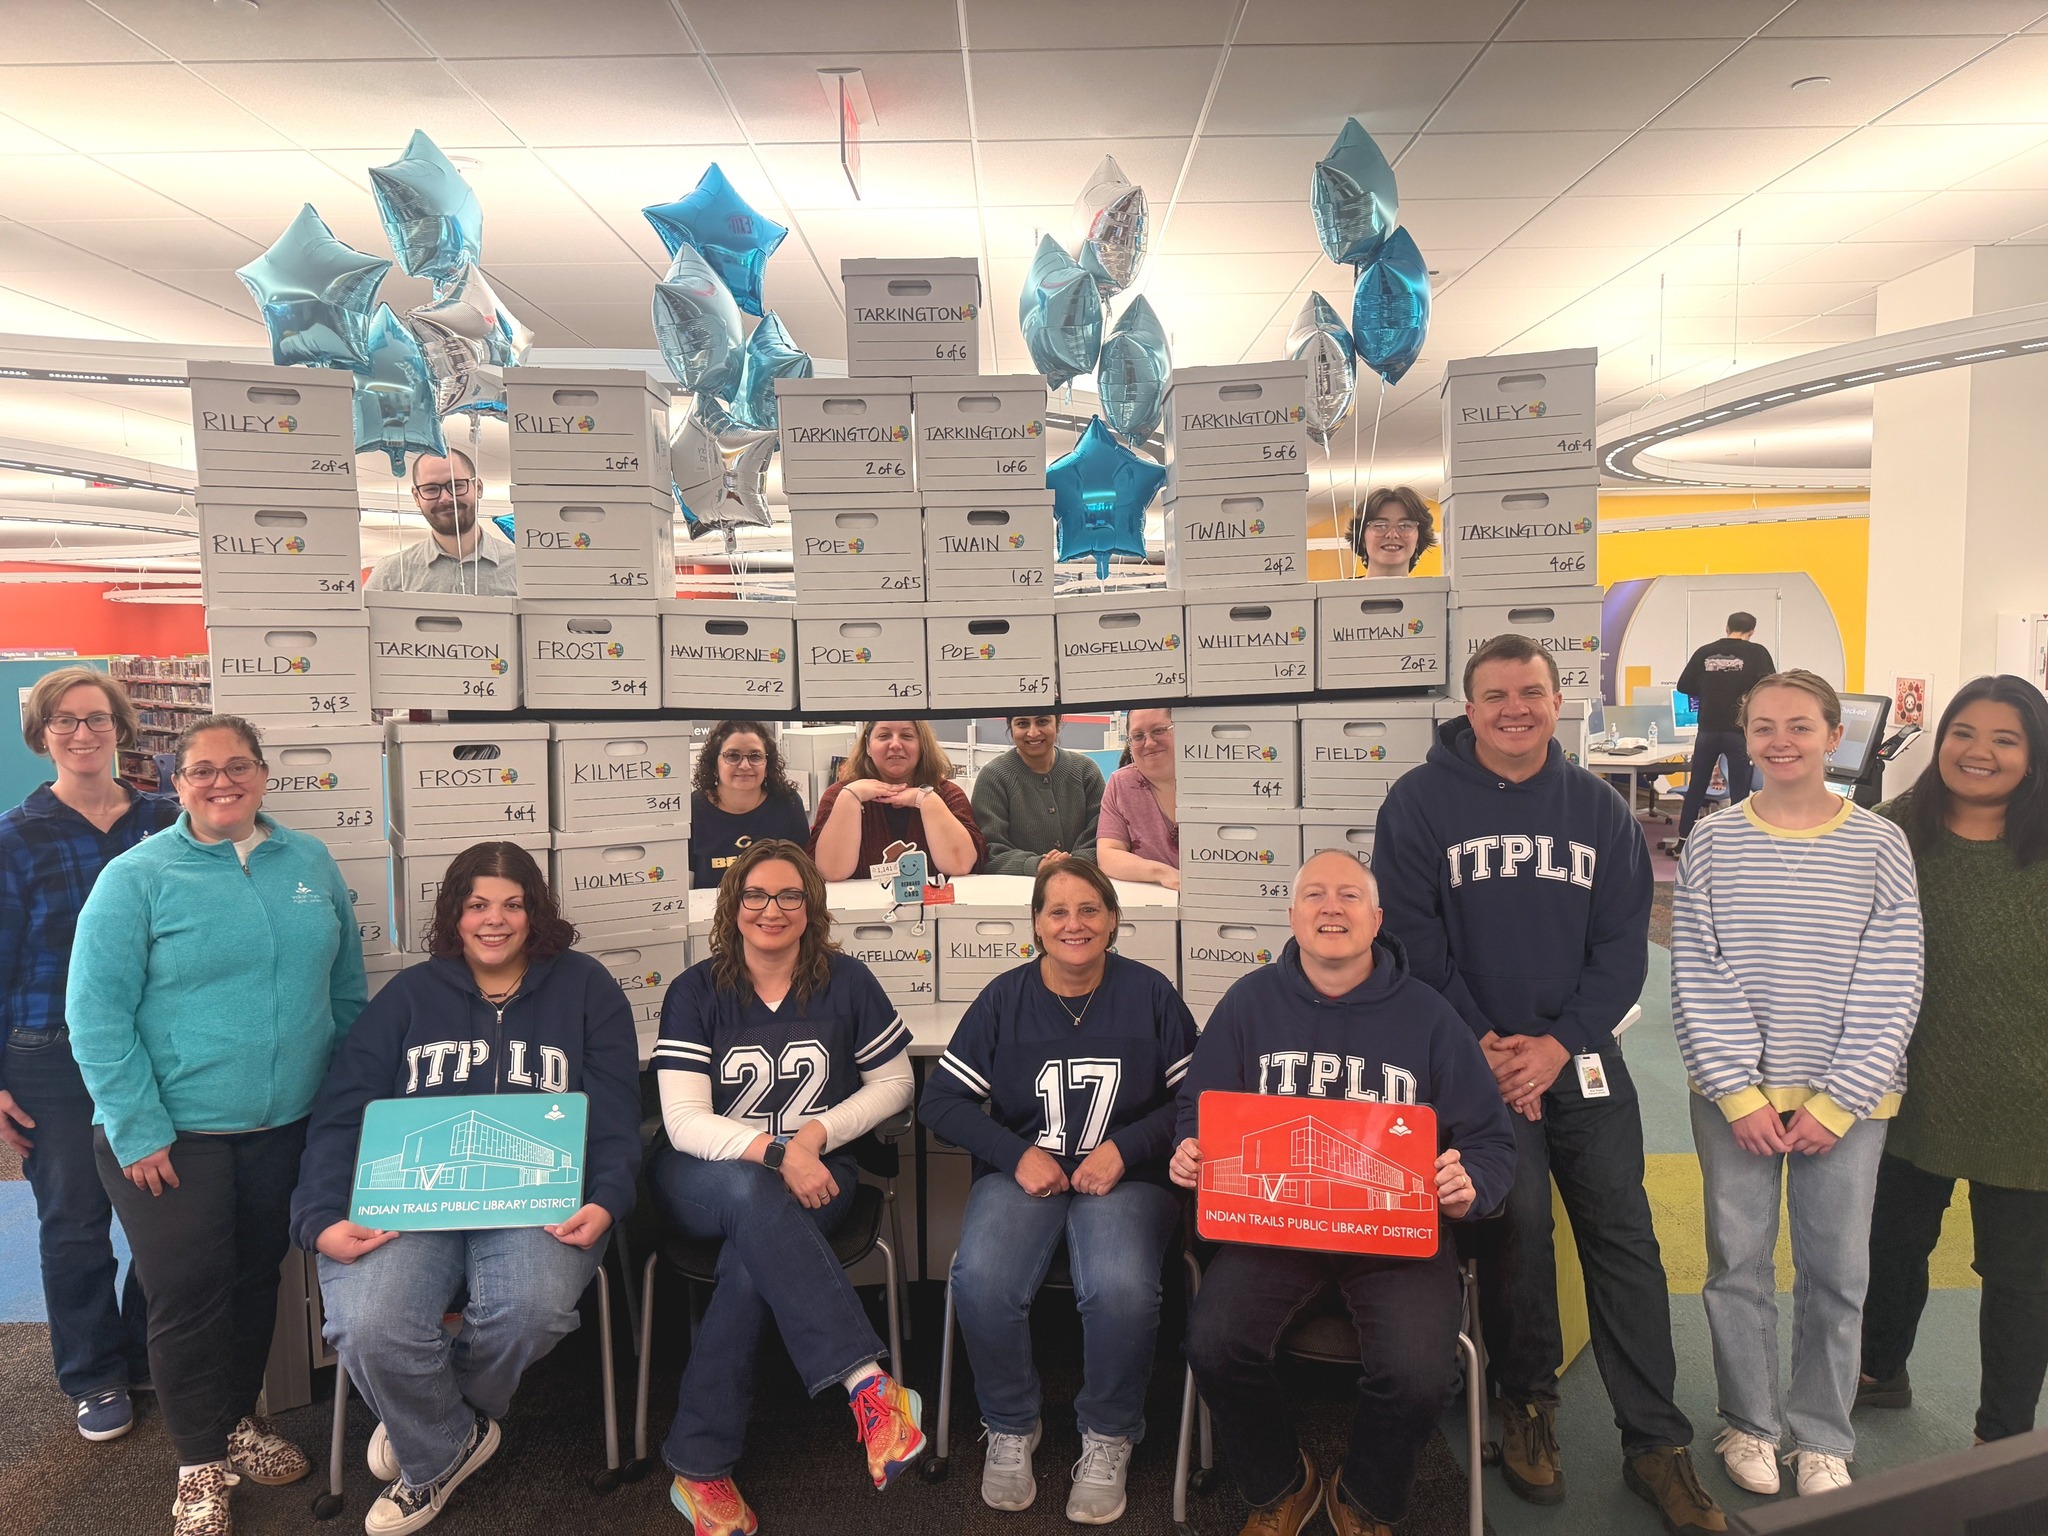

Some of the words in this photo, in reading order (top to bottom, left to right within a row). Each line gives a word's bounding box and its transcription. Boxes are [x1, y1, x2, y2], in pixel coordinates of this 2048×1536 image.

[854, 307, 963, 322] TARKINGTON
[203, 411, 276, 432] RILEY
[515, 411, 575, 433] RILEY
[1182, 408, 1290, 431] TARKINGTON
[1462, 404, 1528, 423] RILEY
[788, 426, 895, 443] TARKINGTON
[925, 424, 1026, 441] TARKINGTON
[526, 529, 571, 549] POE
[1186, 519, 1247, 541] TWAIN
[1459, 520, 1573, 541] TARKINGTON
[213, 534, 283, 555] RILEY
[805, 537, 848, 555] POE
[939, 535, 1000, 553] TWAIN
[1198, 630, 1290, 649] WHITMAN
[1333, 623, 1405, 641] WHITMAN
[375, 642, 500, 659] TARKINGTON
[538, 640, 609, 660] FROST
[671, 644, 770, 662] HAWTHORNE
[811, 646, 856, 664] POE
[941, 643, 980, 660] POE
[1064, 636, 1165, 656] LONGFELLOW
[222, 657, 292, 674] FIELD
[1184, 744, 1262, 761] KILMER
[1315, 746, 1368, 761] FIELD
[420, 767, 502, 788] FROST
[573, 761, 655, 785] KILMER
[267, 775, 320, 793] OPER
[1190, 847, 1258, 863] LONDON
[1446, 834, 1597, 890] ITPLD
[574, 870, 647, 892] HOLMES
[848, 949, 920, 963] GFELLOW
[950, 942, 1019, 959] KILMER
[1190, 947, 1255, 963] LONDON
[720, 1039, 831, 1137] 22
[1259, 1051, 1418, 1106] ITPLD
[1034, 1056, 1122, 1156] 17
[358, 1204, 400, 1216] INDIAN
[402, 1202, 438, 1214] TRAILS
[440, 1200, 481, 1212] PUBLIC
[482, 1198, 528, 1211] LIBRARY
[529, 1197, 577, 1209] DISTRICT
[1205, 1209, 1247, 1224] INDIAN
[1249, 1213, 1286, 1228] TRAILS
[1287, 1217, 1329, 1232] PUBLIC
[1331, 1220, 1379, 1236] LIBRARY
[1382, 1225, 1433, 1240] DISTRICT
